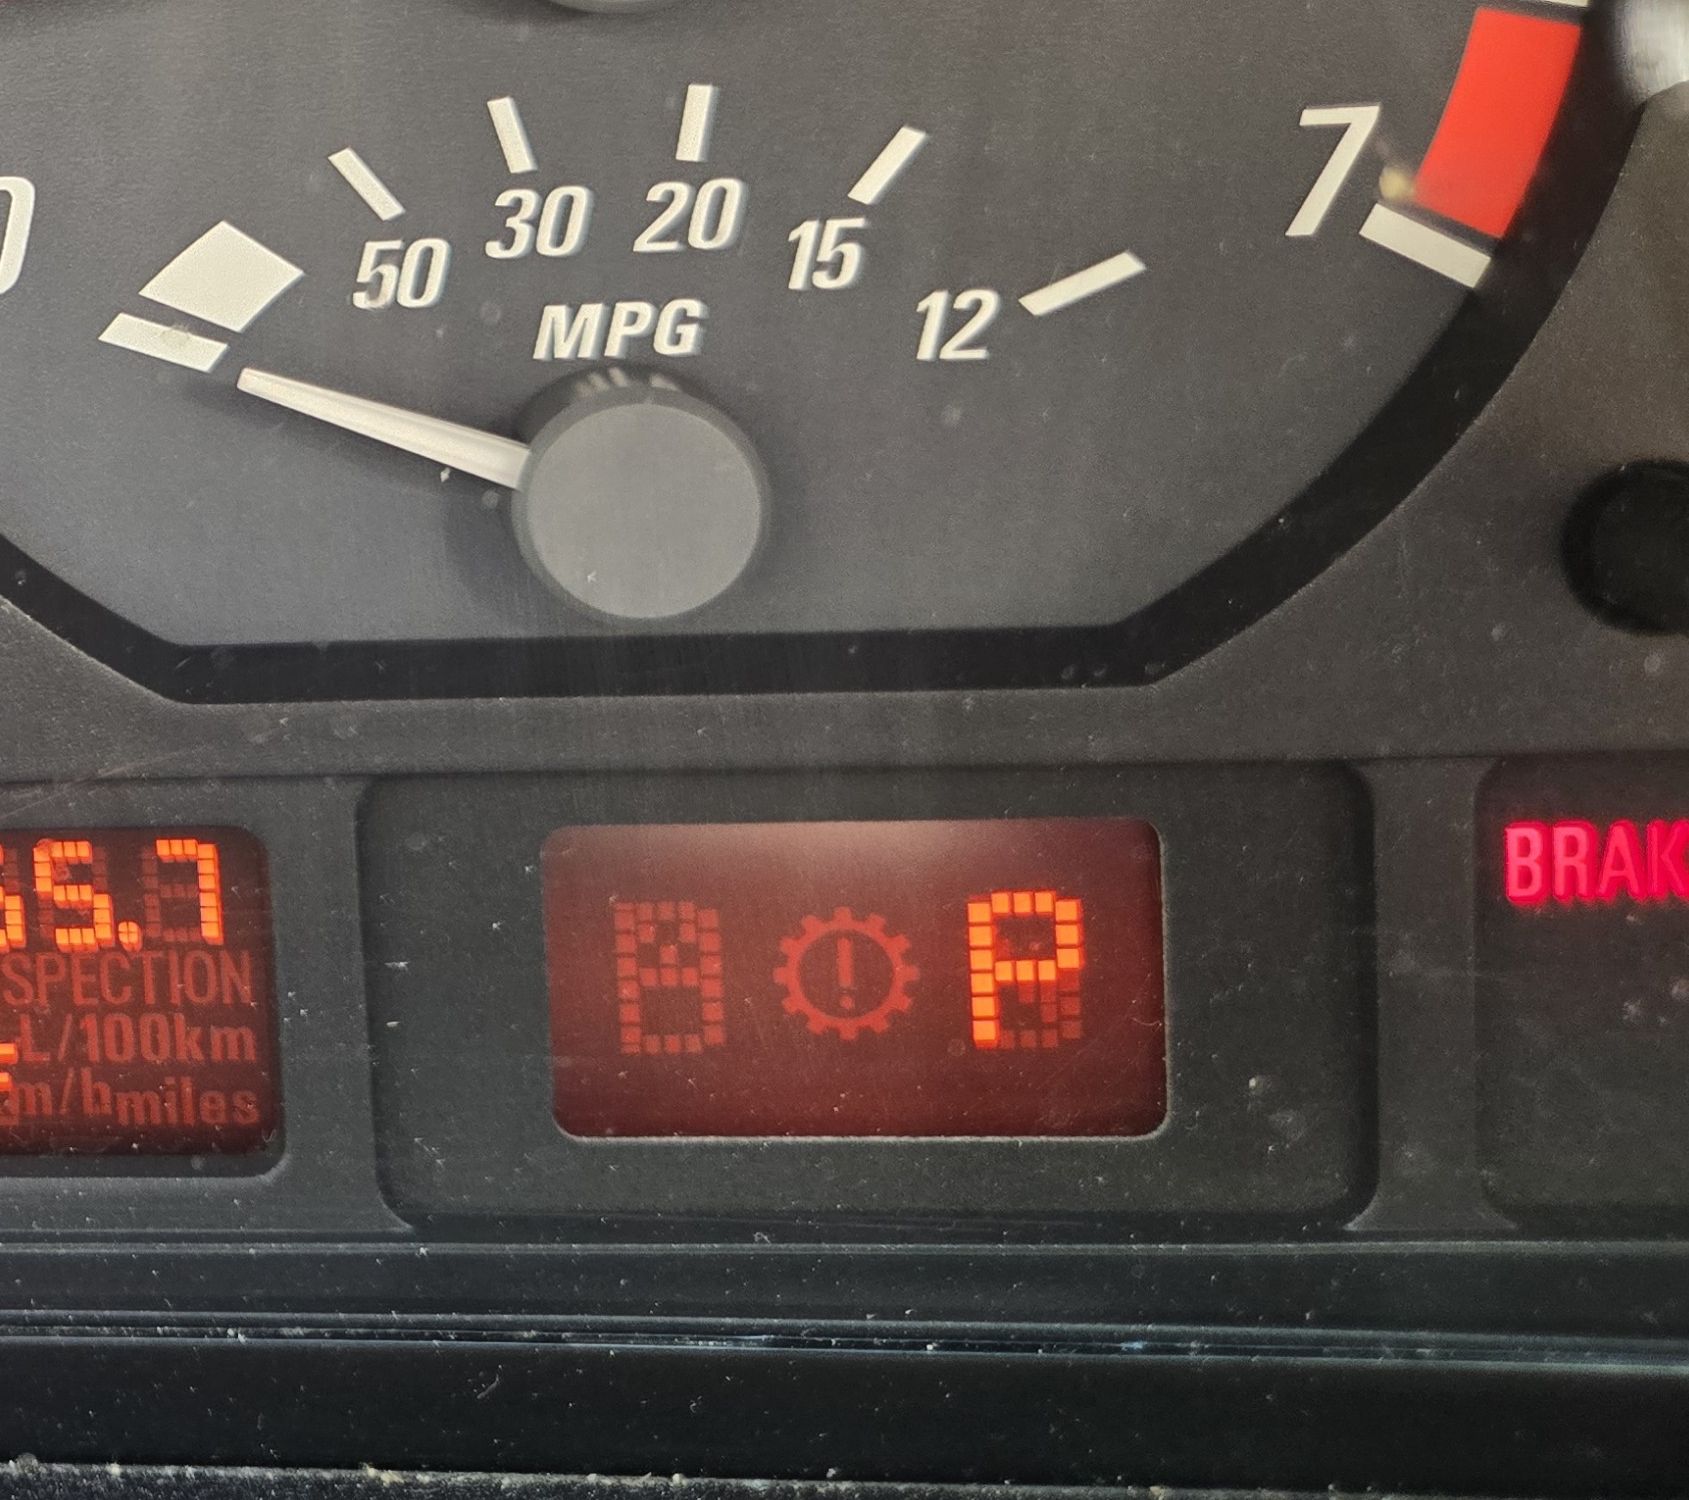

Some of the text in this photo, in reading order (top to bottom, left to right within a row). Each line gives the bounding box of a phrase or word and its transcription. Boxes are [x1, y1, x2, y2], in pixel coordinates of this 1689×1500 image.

[1285, 104, 1381, 237] 7
[485, 185, 590, 259] 30
[633, 178, 743, 252] 20
[353, 238, 450, 309] 50
[788, 217, 866, 290] 15
[533, 298, 704, 360] MPG
[916, 289, 999, 361] 12
[1505, 819, 1689, 904] BRAK
[967, 890, 1084, 1048] P
